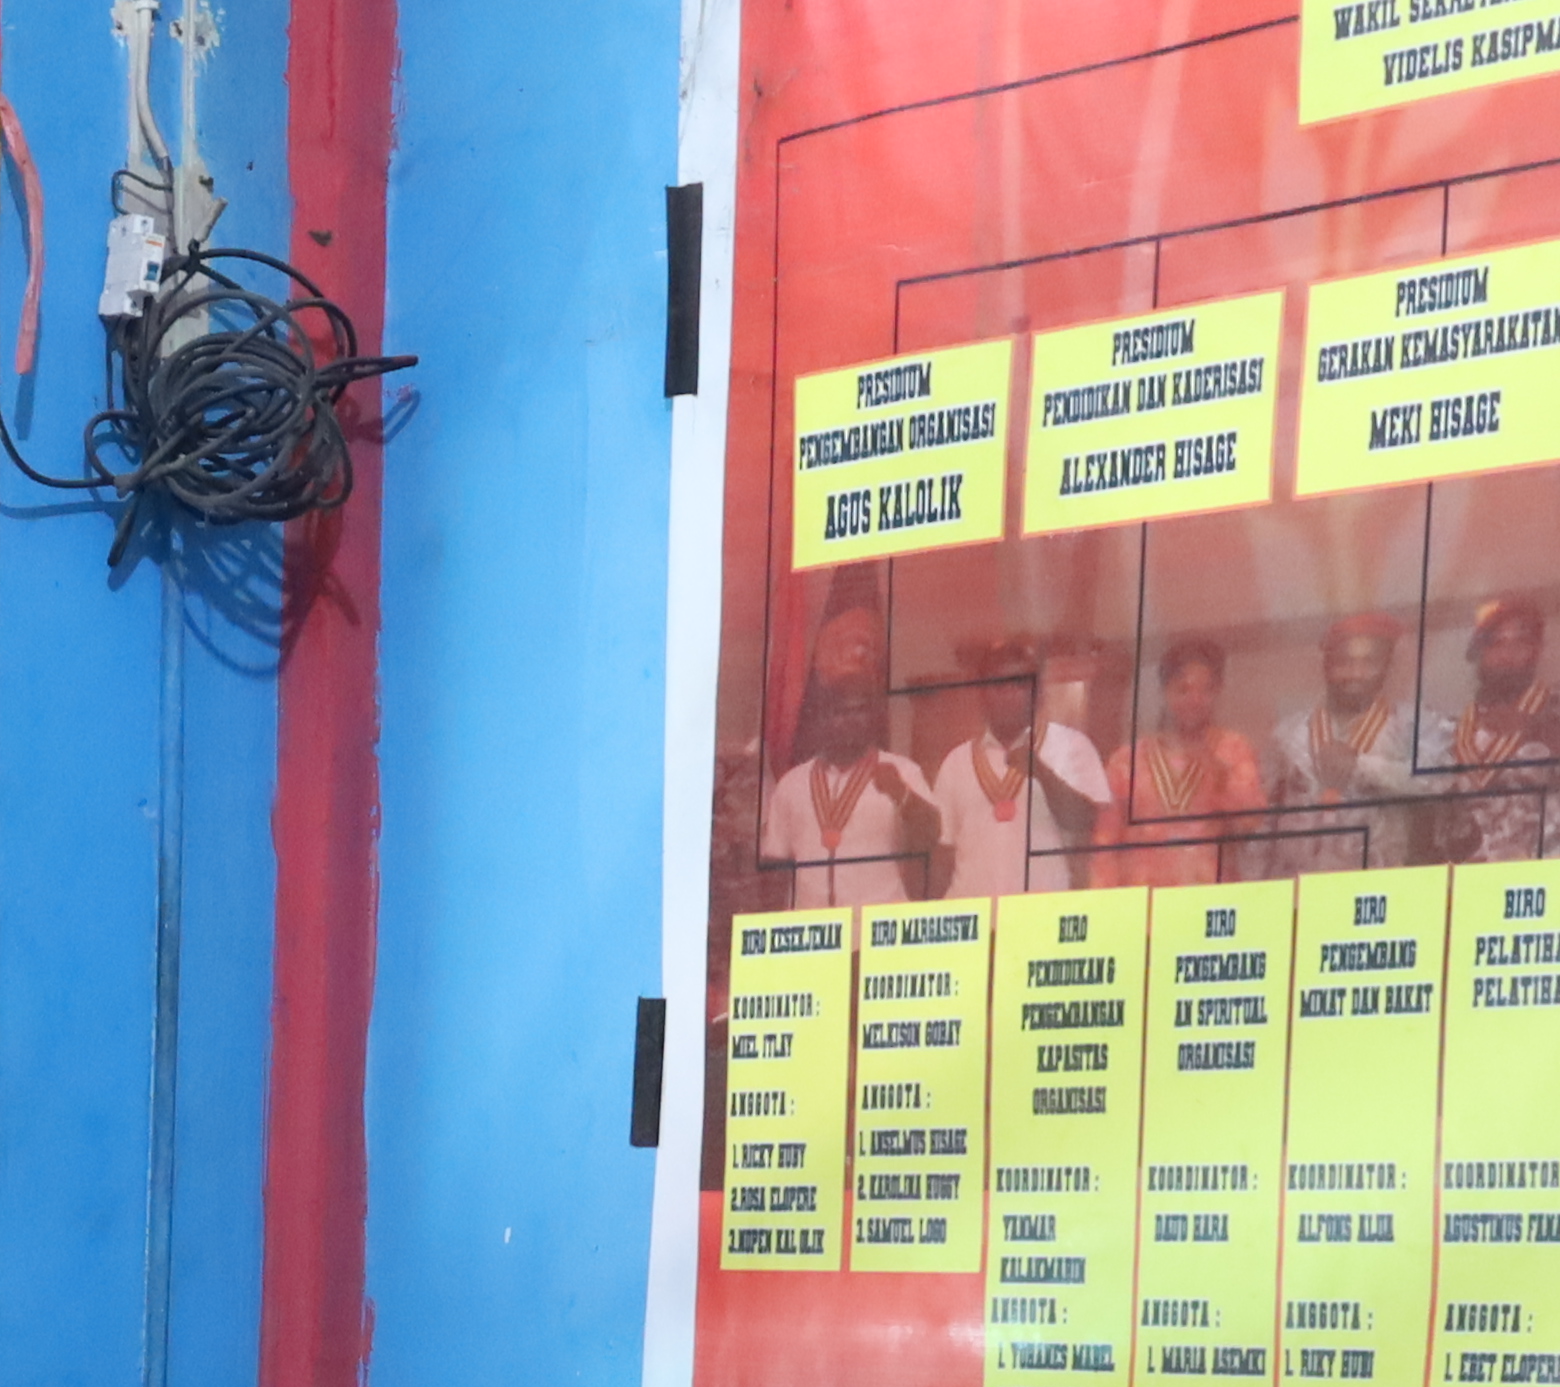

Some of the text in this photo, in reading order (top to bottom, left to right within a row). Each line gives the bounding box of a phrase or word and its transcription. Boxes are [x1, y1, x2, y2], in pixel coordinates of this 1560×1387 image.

[1334, 0, 1400, 40] WAKIL
[1384, 38, 1463, 86] VIDELIS
[1396, 267, 1488, 317] PRESIDIUM
[1112, 319, 1195, 366] PRESIDIUM
[1318, 336, 1394, 382] GERAKAN
[857, 362, 931, 409] PRESIDIUM
[1043, 358, 1264, 427] PENDIDIKAN DAN KADERISASI
[800, 403, 996, 470] PENGEMBANGAN ORGANISASI
[1369, 404, 1422, 450] MEKI
[1060, 443, 1166, 495] ALEXANDER
[825, 474, 963, 540] AGUS KALOLIK
[1354, 896, 1387, 926] BIRO
[1504, 888, 1545, 919] BIRO
[901, 915, 978, 945] MARGASISWA
[1320, 940, 1416, 972] PENGEMBANG
[1198, 996, 1267, 1026] SPIRITUAL
[1351, 987, 1380, 1015] DAN
[1385, 984, 1433, 1014] BAKAT
[1037, 1043, 1108, 1072] KAPASITAS
[1178, 1041, 1255, 1071] ORGANISASI
